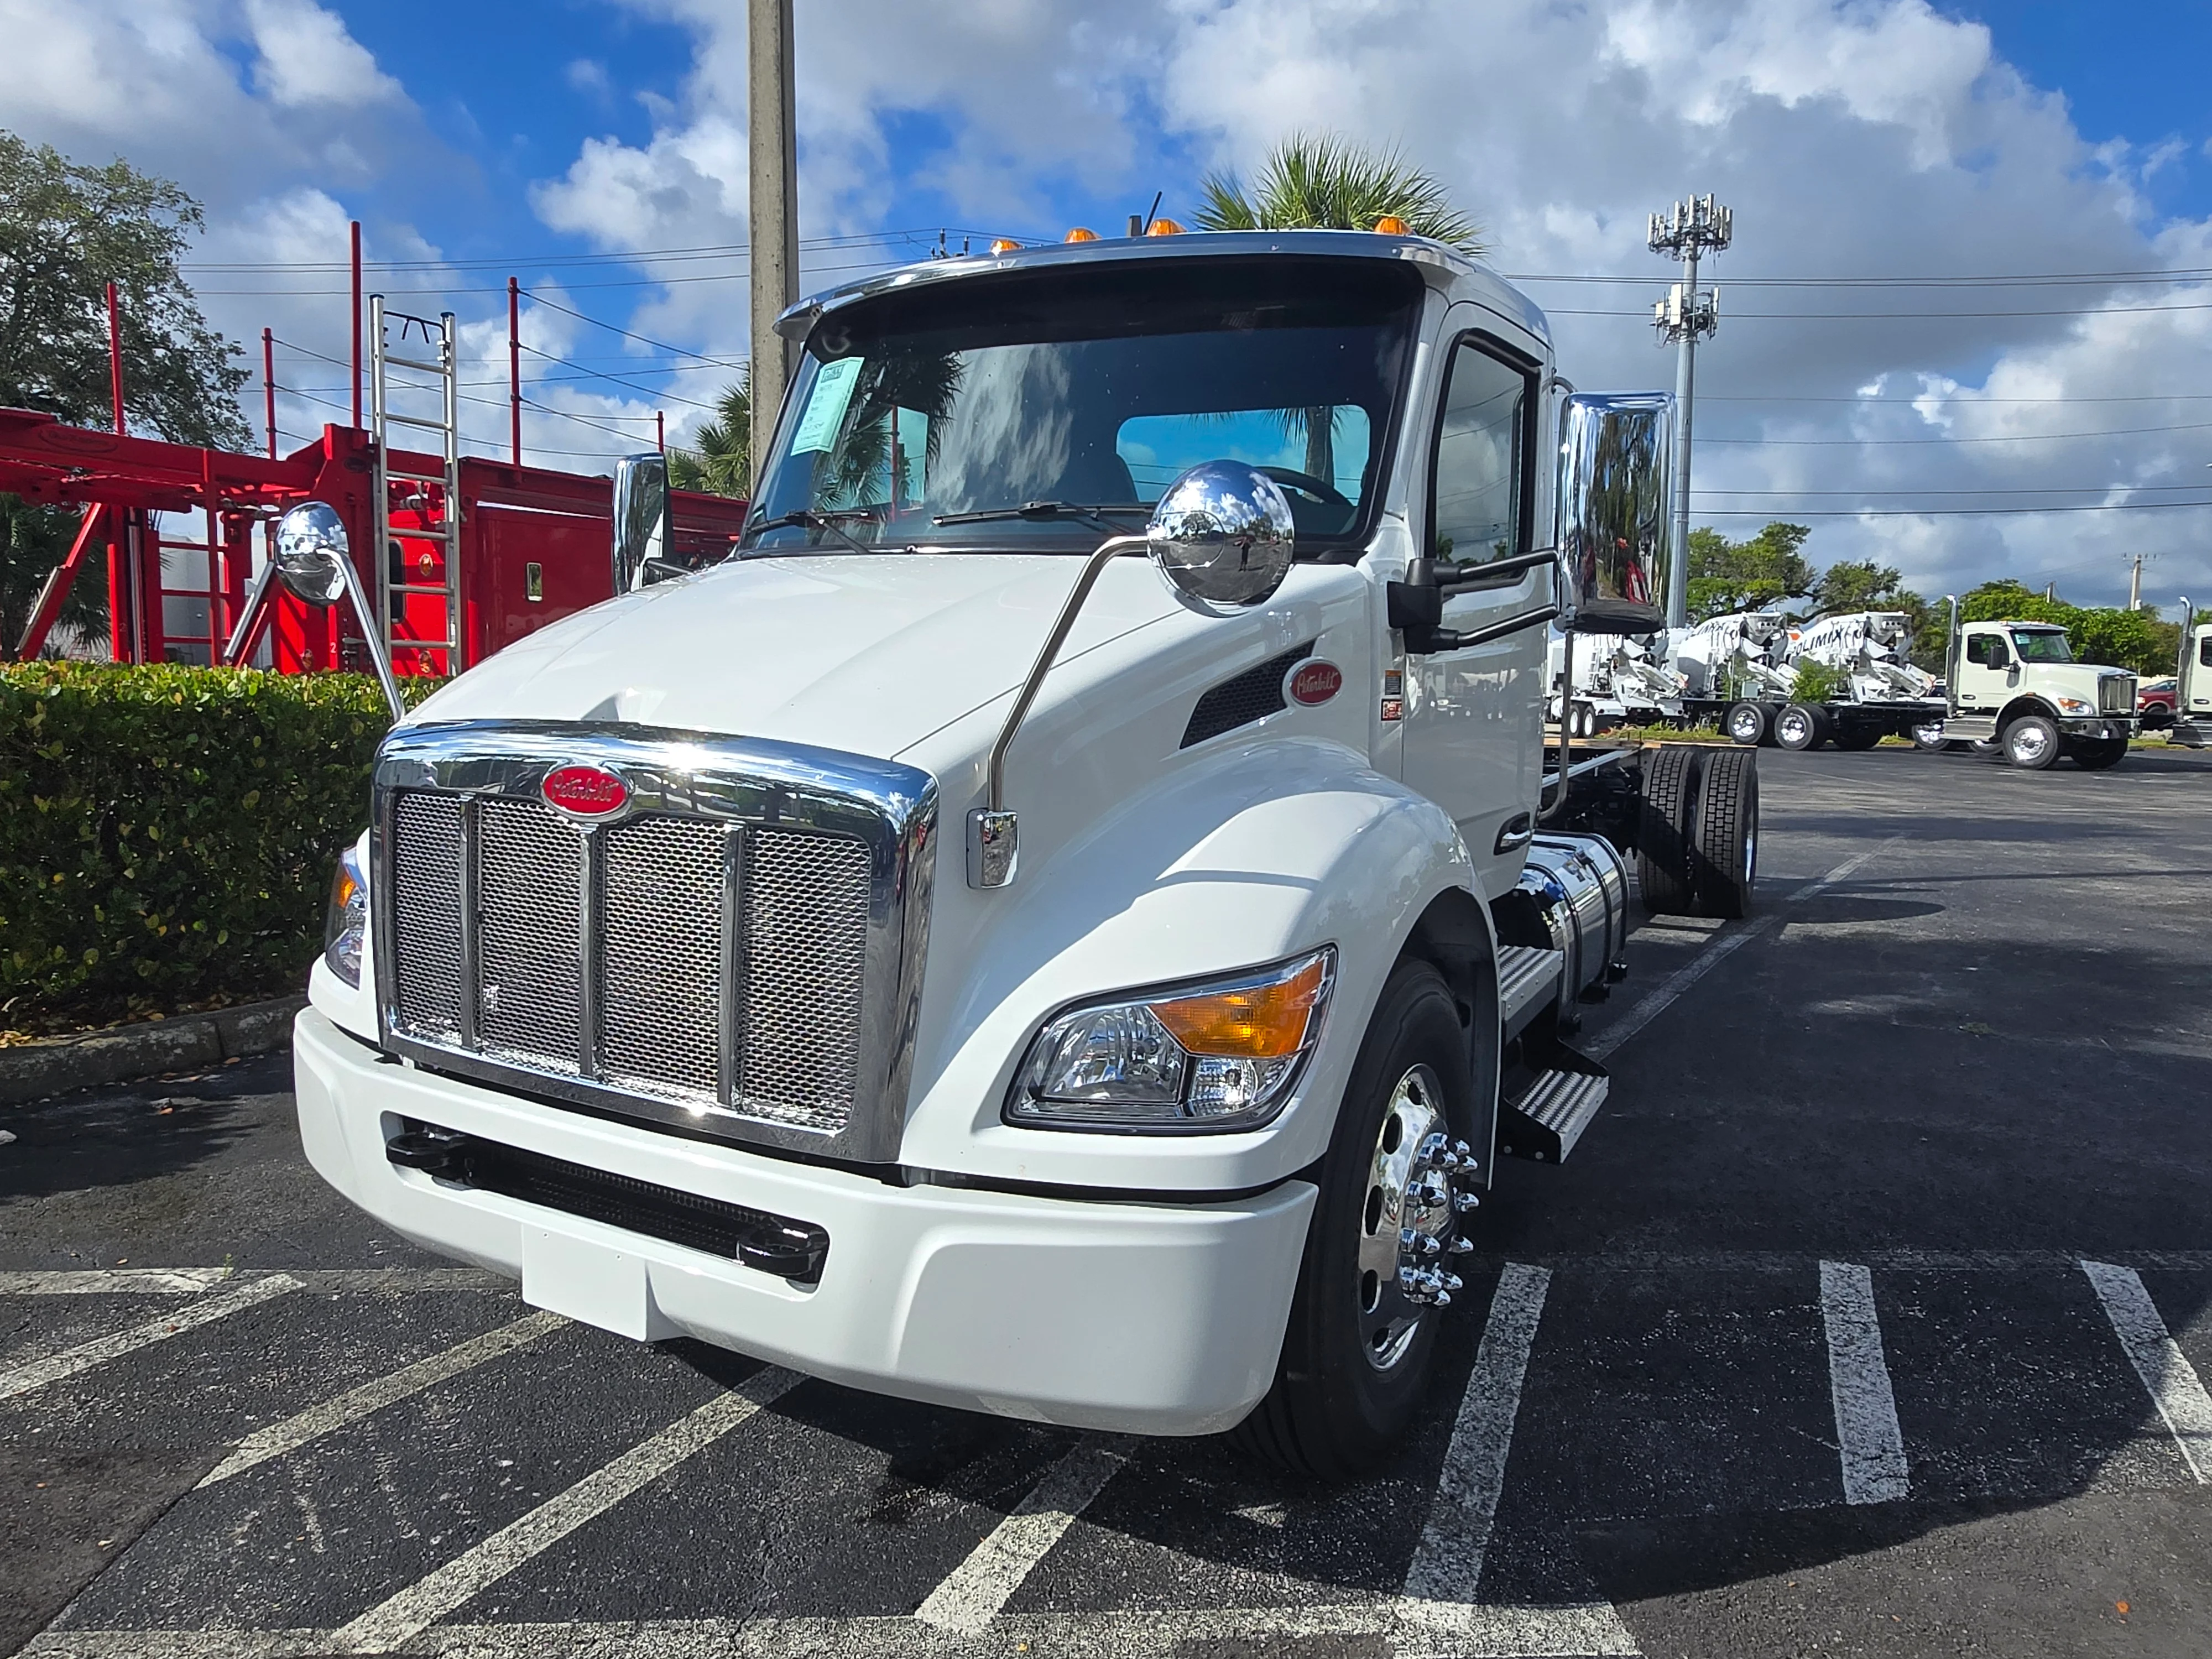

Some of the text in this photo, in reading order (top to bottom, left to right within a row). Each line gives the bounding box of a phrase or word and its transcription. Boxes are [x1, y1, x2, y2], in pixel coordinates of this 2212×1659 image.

[330, 641, 337, 654] 2
[1297, 671, 1338, 696] Peterbilt
[552, 773, 619, 802] Peterbilt
